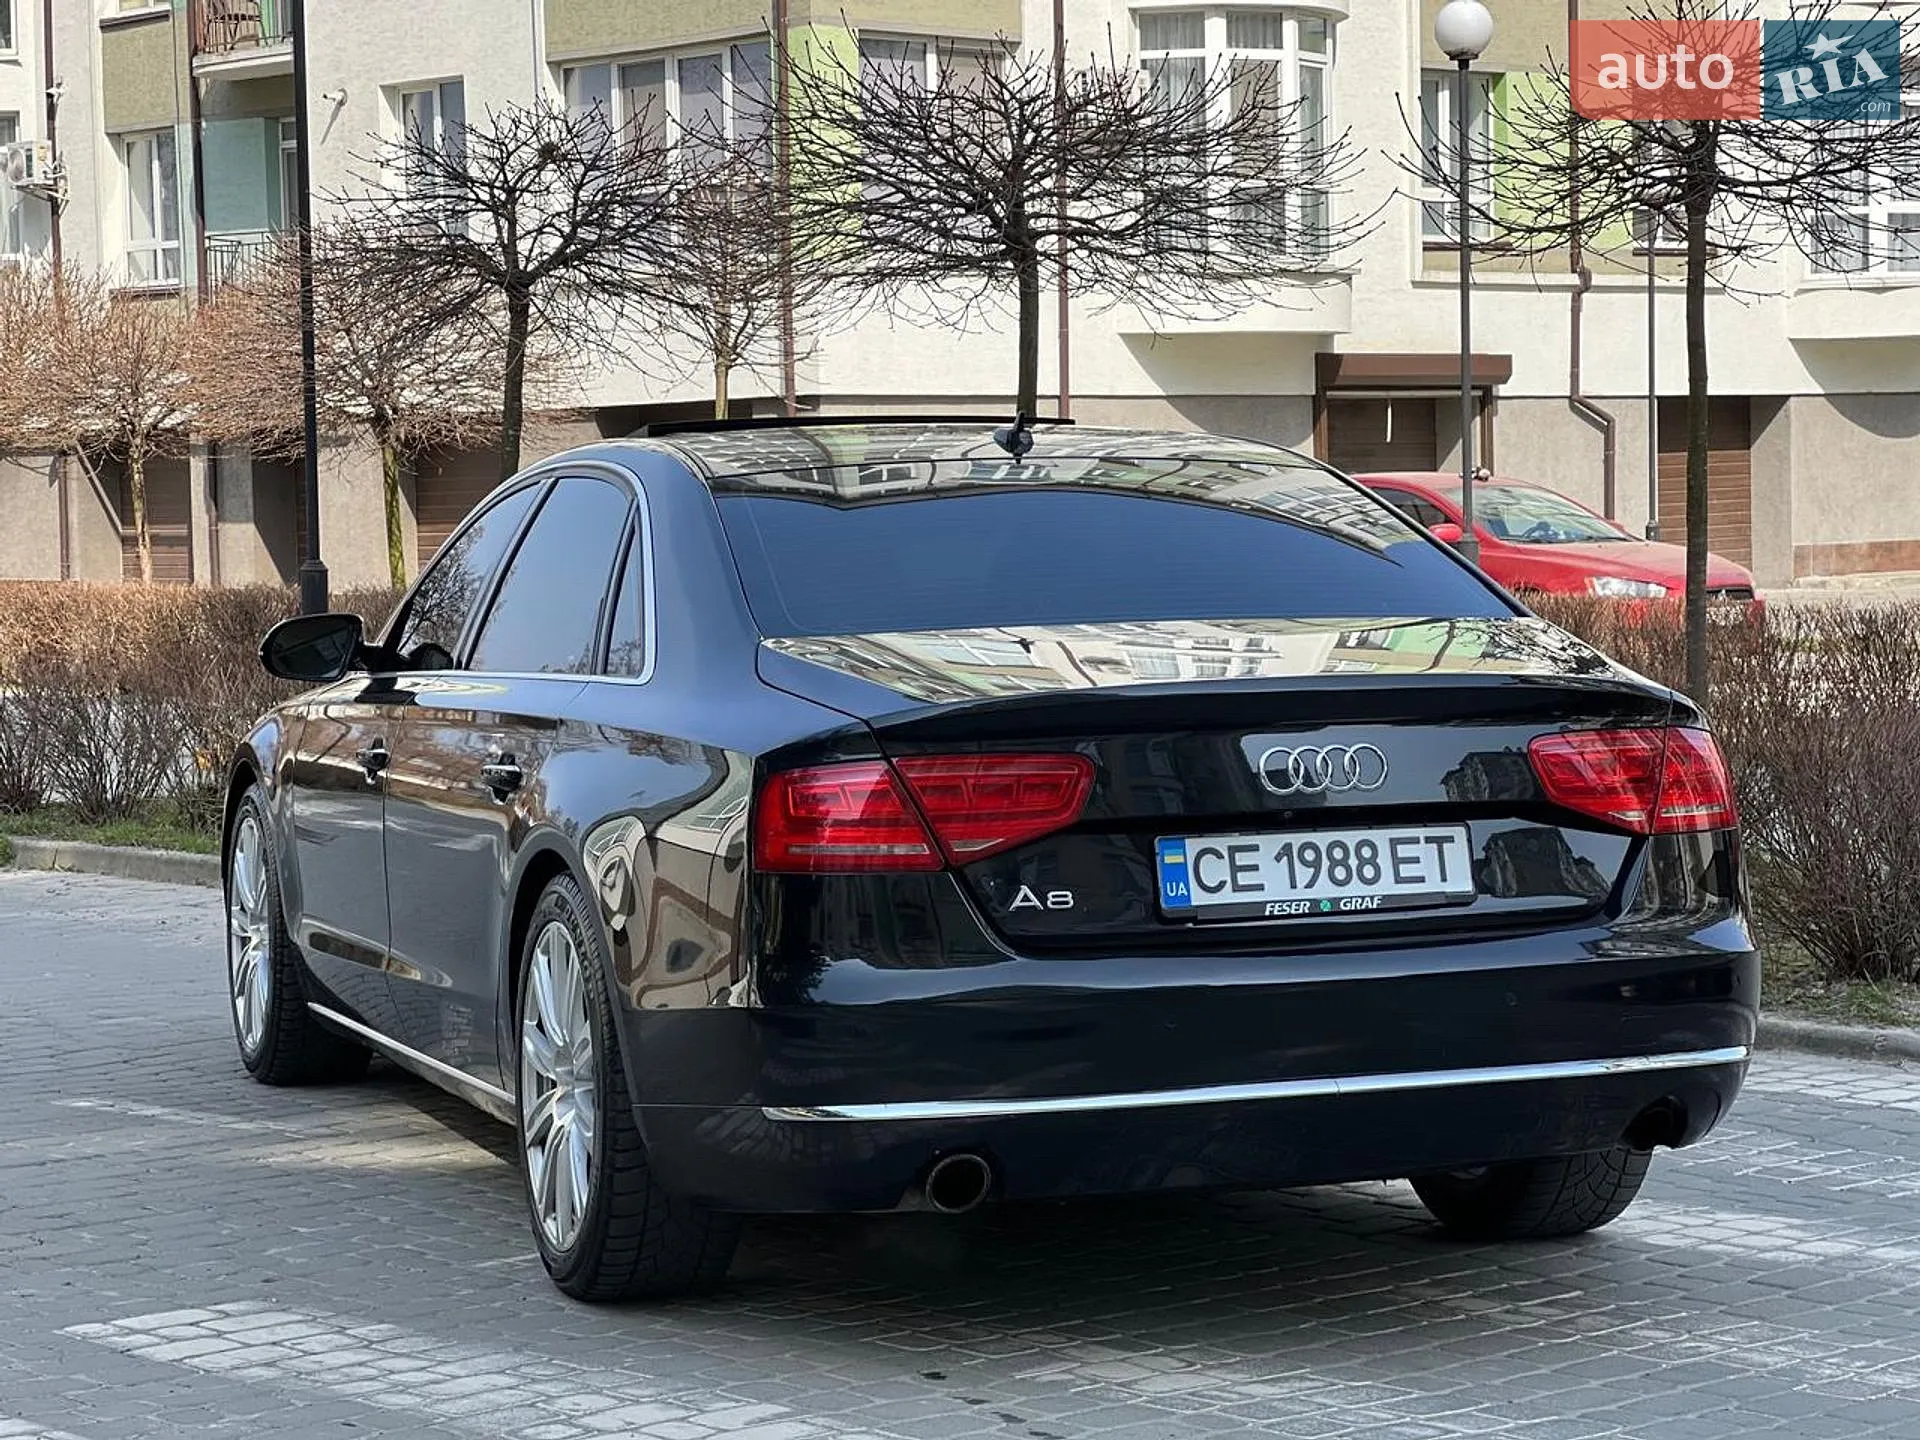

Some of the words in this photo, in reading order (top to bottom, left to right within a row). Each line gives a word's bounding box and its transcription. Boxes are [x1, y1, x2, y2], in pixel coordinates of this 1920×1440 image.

[1193, 844, 1264, 894] CE
[1274, 839, 1382, 889] 1988
[1390, 836, 1454, 885] ET
[1008, 885, 1074, 911] A8
[1166, 880, 1188, 897] UA
[1265, 901, 1311, 916] FESER
[1340, 896, 1382, 910] GRAF
